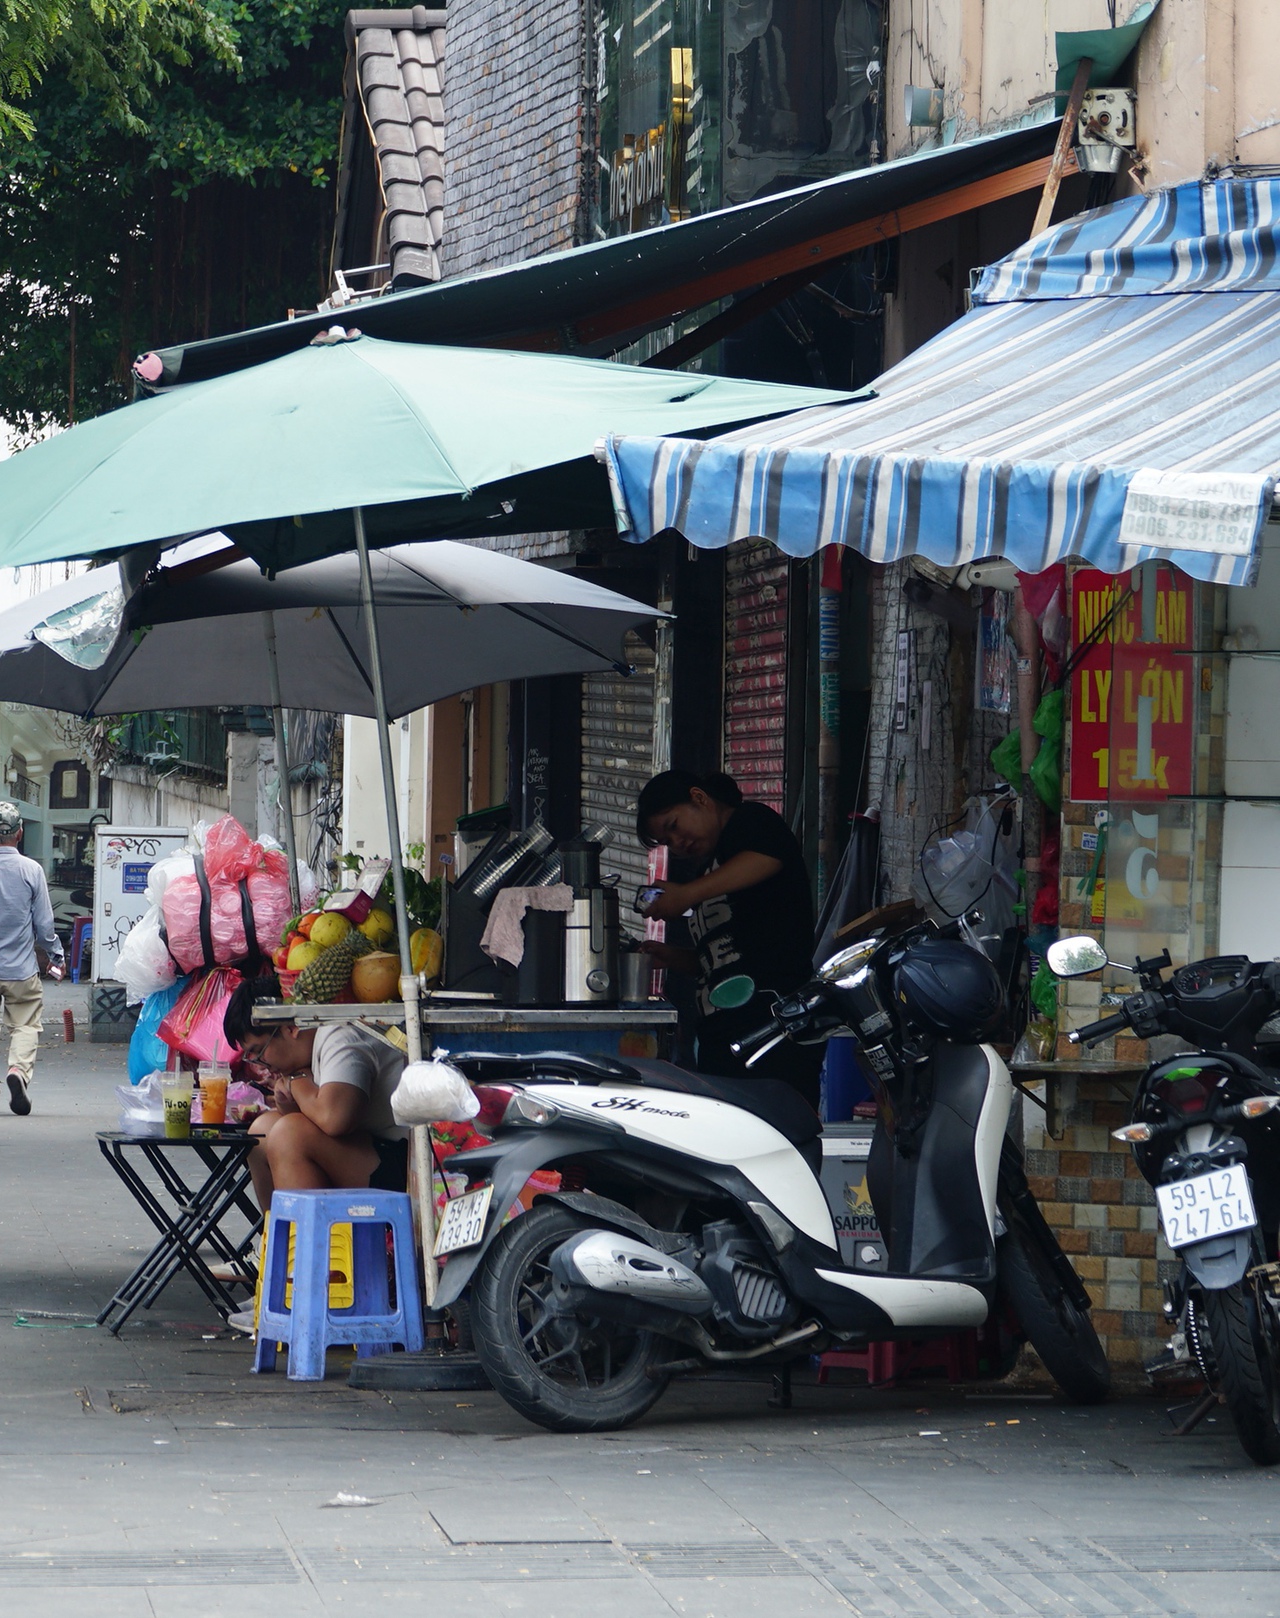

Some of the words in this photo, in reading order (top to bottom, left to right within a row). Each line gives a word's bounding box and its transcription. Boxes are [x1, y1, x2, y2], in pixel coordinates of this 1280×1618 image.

[1078, 578, 1135, 645] NƯỚC
[1080, 669, 1111, 723] LY
[1124, 658, 1184, 724] LỚN
[641, 1106, 691, 1119] mode
[448, 1191, 484, 1225] 59-N3
[1170, 1173, 1236, 1211] 59-L2
[834, 1215, 879, 1231] SAPPO
[1168, 1199, 1250, 1243] 247.64
